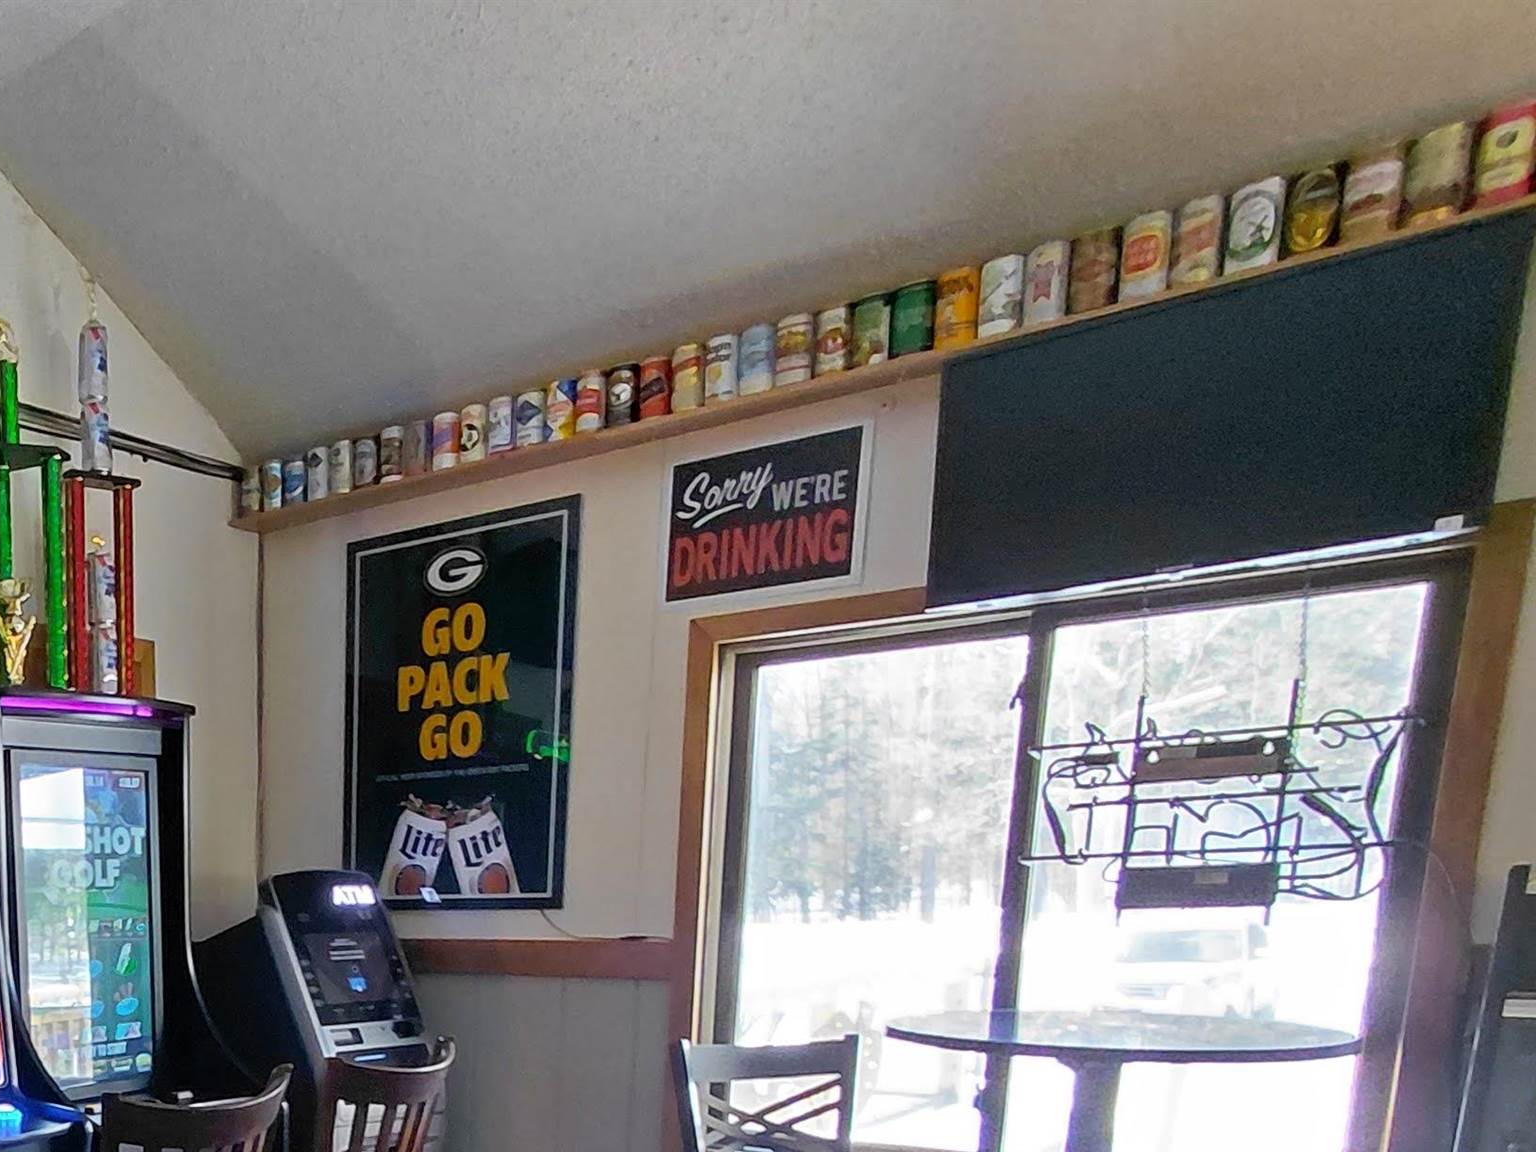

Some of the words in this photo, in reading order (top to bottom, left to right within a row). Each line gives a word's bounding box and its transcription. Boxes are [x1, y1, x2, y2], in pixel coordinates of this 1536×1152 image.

[675, 462, 773, 520] Sorry
[672, 508, 850, 588] DRINKING
[421, 602, 486, 658] GO
[397, 652, 511, 713] PACK
[417, 710, 483, 762] GO
[399, 823, 447, 862] Lite
[457, 824, 505, 868] Lite
[52, 858, 121, 888] GOLF
[332, 885, 376, 905] ATM
